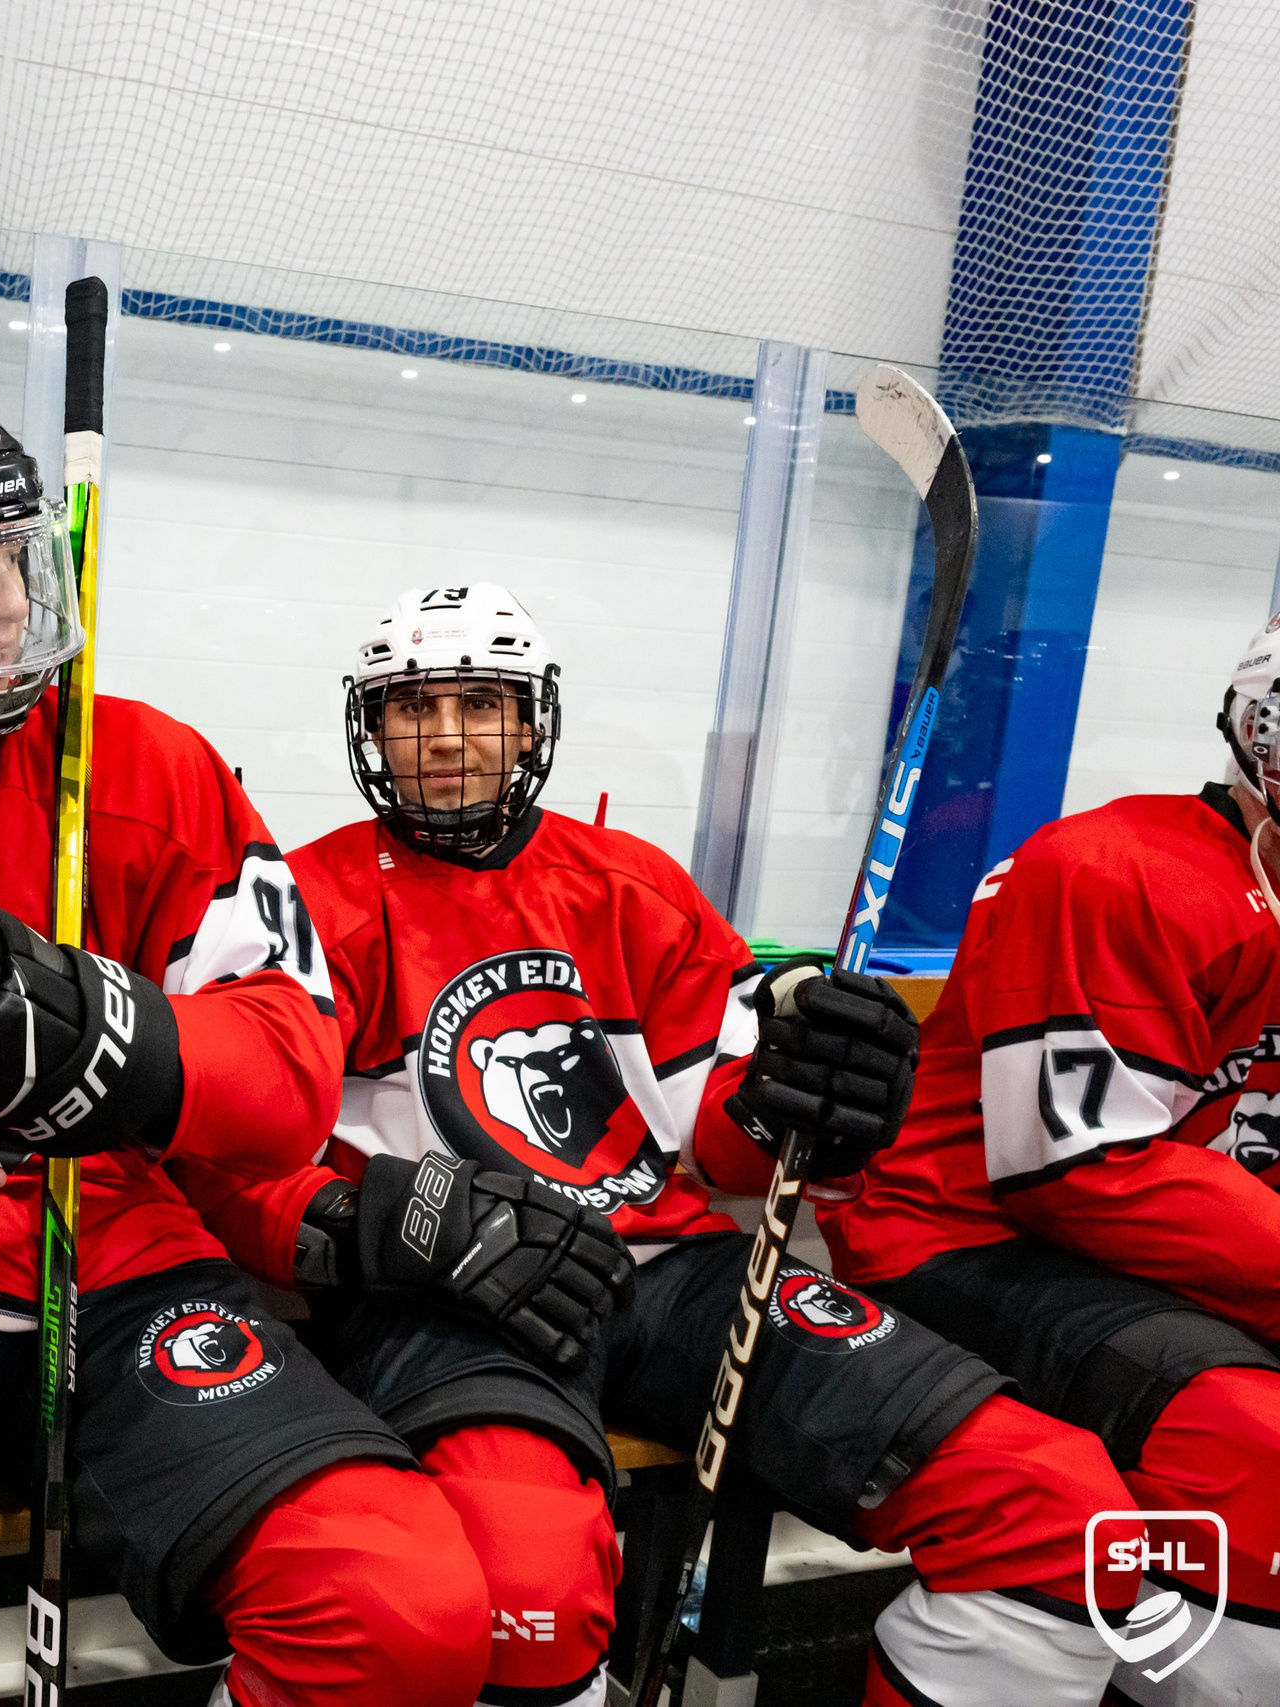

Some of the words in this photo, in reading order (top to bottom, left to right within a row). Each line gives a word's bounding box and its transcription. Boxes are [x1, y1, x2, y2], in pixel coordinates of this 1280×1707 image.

[918, 690, 938, 751] BAUER
[250, 873, 313, 977] 91
[428, 963, 508, 1079] HOCKEY
[1038, 1047, 1117, 1144] 17
[451, 1241, 484, 1280] SUPREME
[67, 1280, 78, 1394] BAUER
[138, 1306, 177, 1369] HOCKEY
[695, 1159, 800, 1493] BAUER
[847, 1311, 896, 1350] MOSCOW
[197, 1361, 277, 1402] MOSCOW
